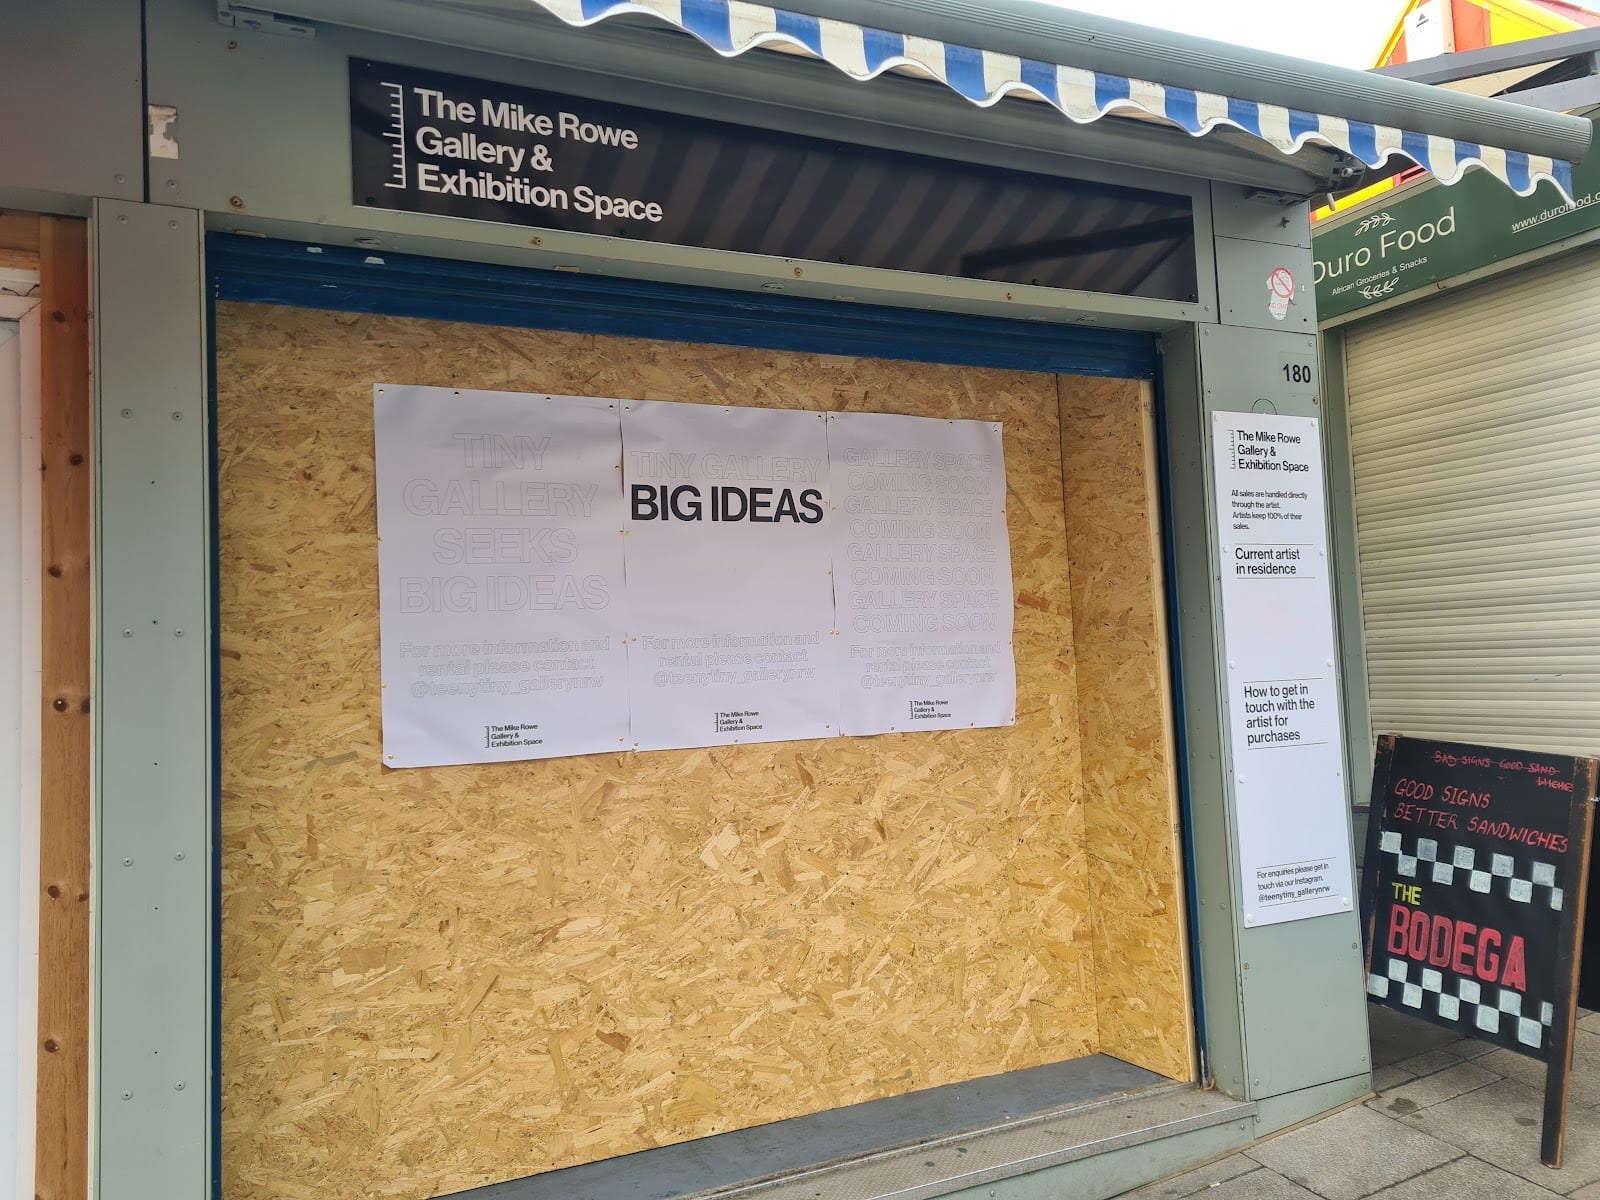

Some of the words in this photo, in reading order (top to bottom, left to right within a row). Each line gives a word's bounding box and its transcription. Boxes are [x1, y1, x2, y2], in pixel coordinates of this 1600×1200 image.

[413, 87, 476, 124] The
[482, 99, 554, 136] Mike
[559, 112, 639, 150] Rowe
[415, 127, 525, 172] Gallery
[530, 144, 553, 172] &
[417, 163, 568, 210] Exhibition
[573, 185, 663, 222] Space
[1380, 206, 1456, 259] Food
[1332, 282, 1355, 296] African
[1355, 268, 1391, 288] Groceries
[1391, 265, 1398, 275] &
[1400, 256, 1428, 271] Snacks
[1282, 363, 1311, 383] 180
[1236, 430, 1254, 441] The
[1255, 431, 1276, 442] Mike
[1277, 432, 1301, 444] Rowe
[452, 433, 552, 471] TINY
[845, 448, 930, 470] GALLERY
[935, 452, 992, 472] SPACE
[1237, 444, 1268, 458] Gallery
[1270, 446, 1276, 456] &
[631, 451, 696, 479] TINY
[701, 453, 822, 483] GALLERY
[1238, 459, 1281, 471] Exhibition
[1282, 460, 1309, 473] Space
[848, 472, 932, 492] COMING
[936, 474, 990, 495] SOON
[402, 478, 600, 518] GALLERY
[631, 484, 702, 521] BIG
[711, 486, 824, 523] IDEAS
[1231, 489, 1239, 497] All
[1239, 490, 1255, 498] sales
[1265, 490, 1287, 499] handled
[1288, 491, 1308, 500] directly
[845, 496, 934, 515] GALLERY
[938, 498, 992, 517] SPACE
[1232, 501, 1255, 510] through
[1265, 501, 1281, 509] artist.
[1233, 522, 1250, 530] sales.
[1252, 512, 1267, 520] keep
[1267, 512, 1283, 520] 100%
[1284, 512, 1289, 520] of
[1290, 512, 1302, 520] their
[851, 519, 935, 539] COMING
[938, 521, 991, 540] SOON
[433, 528, 578, 565] SEEKS
[848, 543, 936, 562] GALLERY
[938, 543, 996, 562] SPACE
[1235, 547, 1274, 560] Current
[1275, 548, 1301, 560] artist
[852, 567, 935, 585] COMING
[938, 567, 994, 586] SOON
[1236, 562, 1246, 575] in
[1247, 562, 1297, 575] residence
[399, 576, 478, 613] BIG
[486, 575, 610, 612] IDEAS
[849, 590, 938, 610] GALLERY
[940, 590, 999, 609] SPACE
[853, 614, 938, 633] COMING
[943, 613, 997, 632] SOON
[399, 641, 431, 658] For
[433, 643, 480, 658] more
[482, 638, 580, 655] information
[581, 635, 610, 652] and
[642, 635, 669, 650] For
[671, 637, 710, 650] more
[712, 632, 793, 648] information
[794, 630, 820, 646] and
[418, 659, 471, 677] rental
[473, 658, 530, 678] please
[533, 655, 595, 673] contact
[659, 652, 702, 668] rental
[705, 650, 752, 669] please
[753, 648, 809, 664] contact
[1244, 686, 1268, 699] How
[1270, 686, 1280, 697] to
[1282, 684, 1298, 699] get
[1300, 683, 1309, 695] in
[1245, 700, 1275, 714] touch
[1277, 699, 1297, 711] with
[1299, 698, 1315, 710] the
[520, 723, 538, 731] Rowe
[1246, 716, 1273, 729] artist
[1274, 714, 1289, 727] for
[491, 740, 522, 748] Exhibition
[1247, 730, 1301, 747] purchases
[1433, 750, 1457, 767] BAD
[1461, 755, 1491, 768] SIGNS
[1499, 759, 1523, 770] GOOD
[1528, 762, 1557, 776] SAND
[1394, 778, 1434, 801] GOOD
[1441, 785, 1492, 809] SIGNS
[1394, 802, 1459, 830] BETTER
[1467, 815, 1569, 854] SANDWICHES
[1257, 871, 1267, 880] For
[1268, 867, 1295, 879] enquiries
[1294, 864, 1313, 875] please
[1314, 863, 1323, 873] get
[1323, 862, 1329, 870] in
[1257, 881, 1275, 891] touch
[1275, 880, 1284, 889] via
[1284, 879, 1294, 887] our
[1294, 875, 1324, 885] Instagram.
[1391, 881, 1423, 906] THE
[1387, 903, 1527, 993] BODEGA
